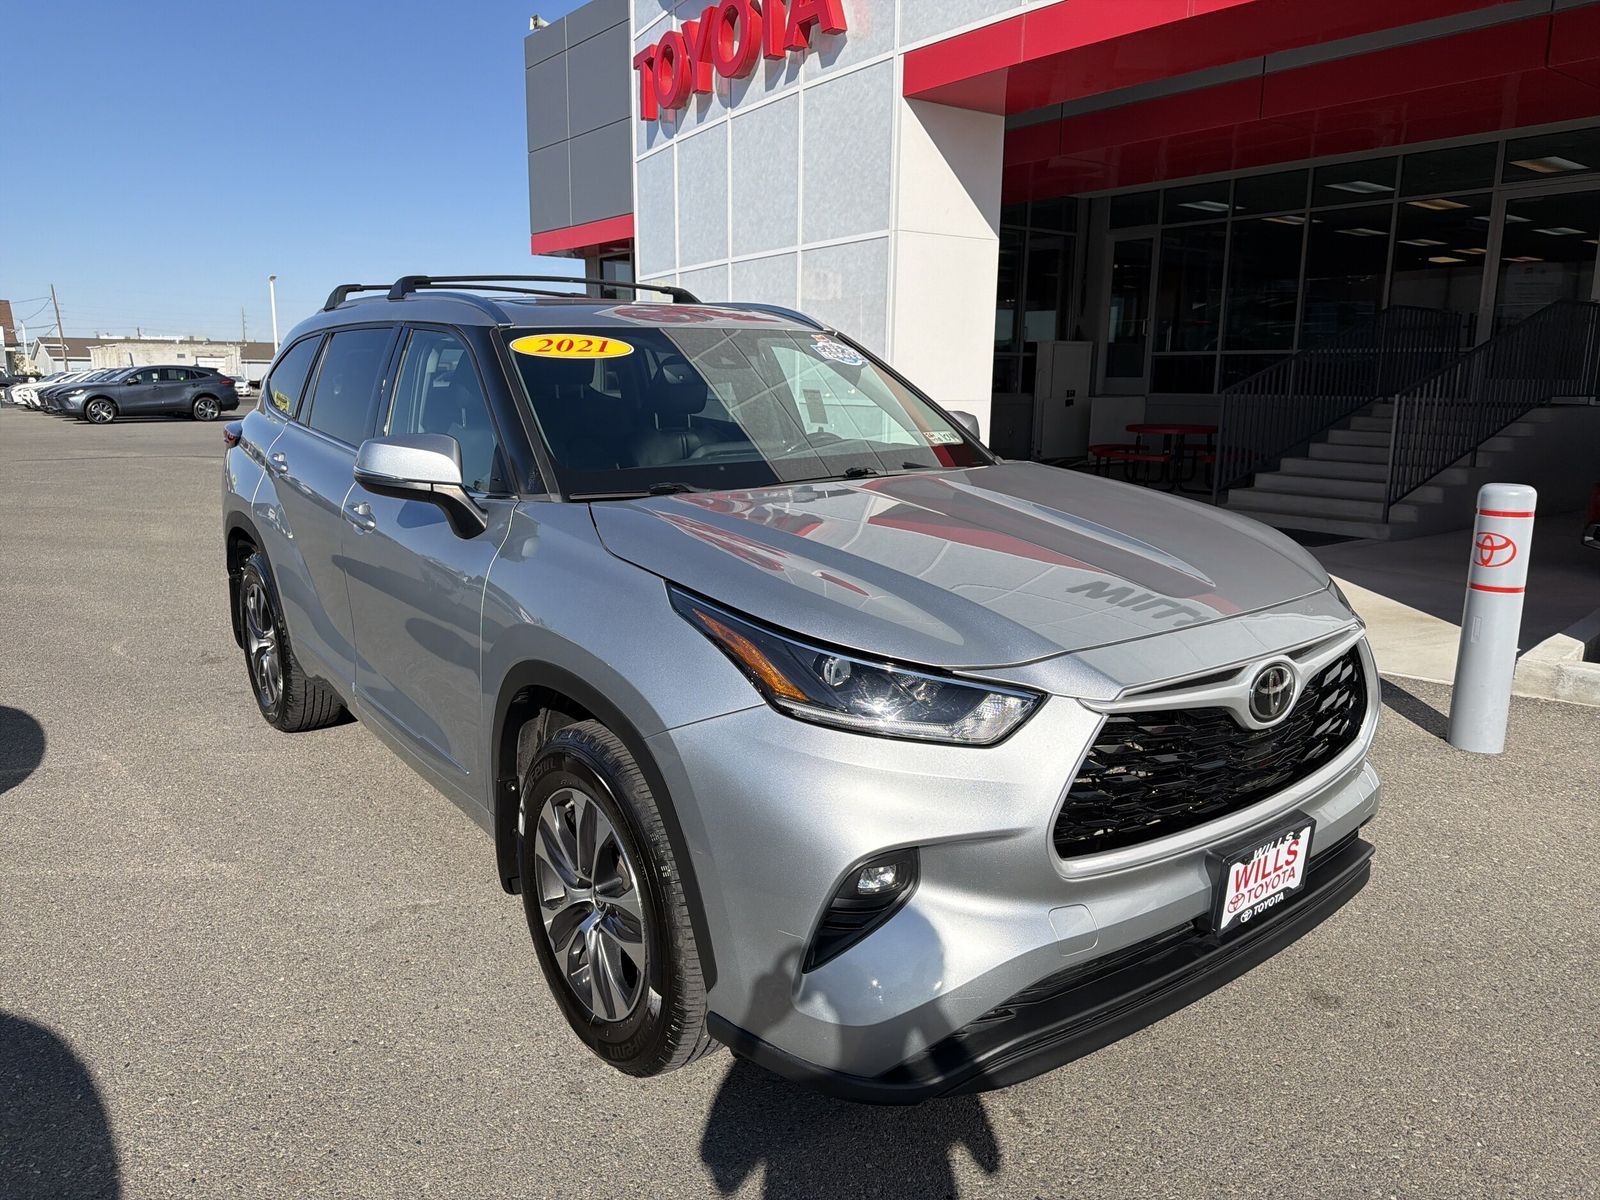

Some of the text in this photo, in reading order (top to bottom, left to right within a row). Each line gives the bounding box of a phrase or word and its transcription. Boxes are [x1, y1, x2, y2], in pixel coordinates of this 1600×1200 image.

[535, 338, 609, 353] 2021
[1253, 832, 1295, 859] WILLS
[1234, 839, 1299, 893] WILLS
[1246, 866, 1296, 904] TOYOTA
[1253, 891, 1285, 916] TOYOTA
